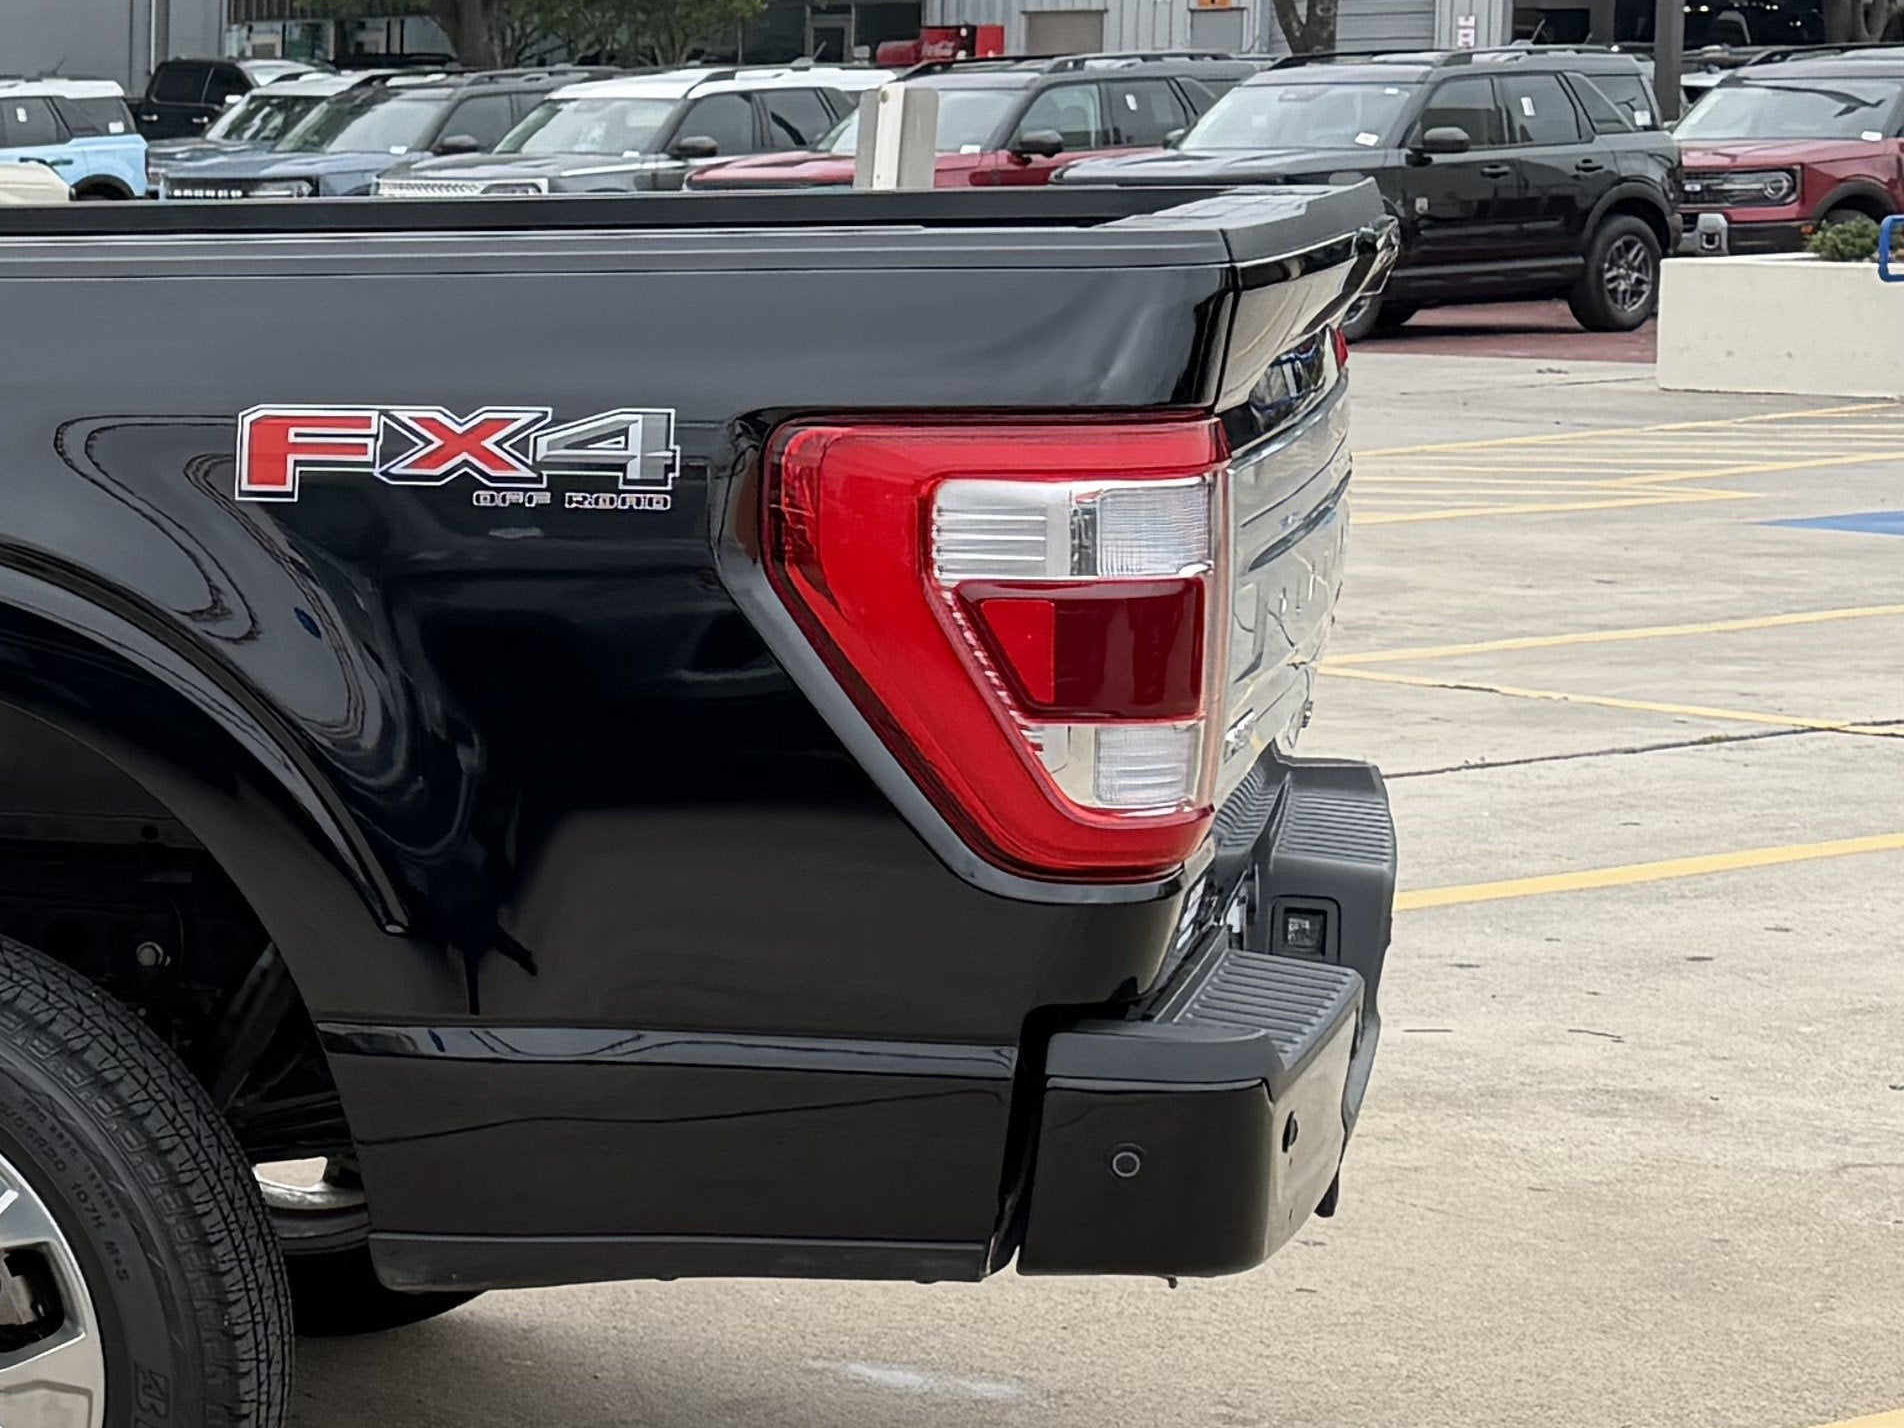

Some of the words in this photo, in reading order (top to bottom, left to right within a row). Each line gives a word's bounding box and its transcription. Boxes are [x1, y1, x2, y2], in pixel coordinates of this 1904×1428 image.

[235, 403, 681, 502] FX4
[472, 490, 551, 508] OFF
[564, 491, 672, 511] ROAD
[71, 1181, 106, 1229] 107H
